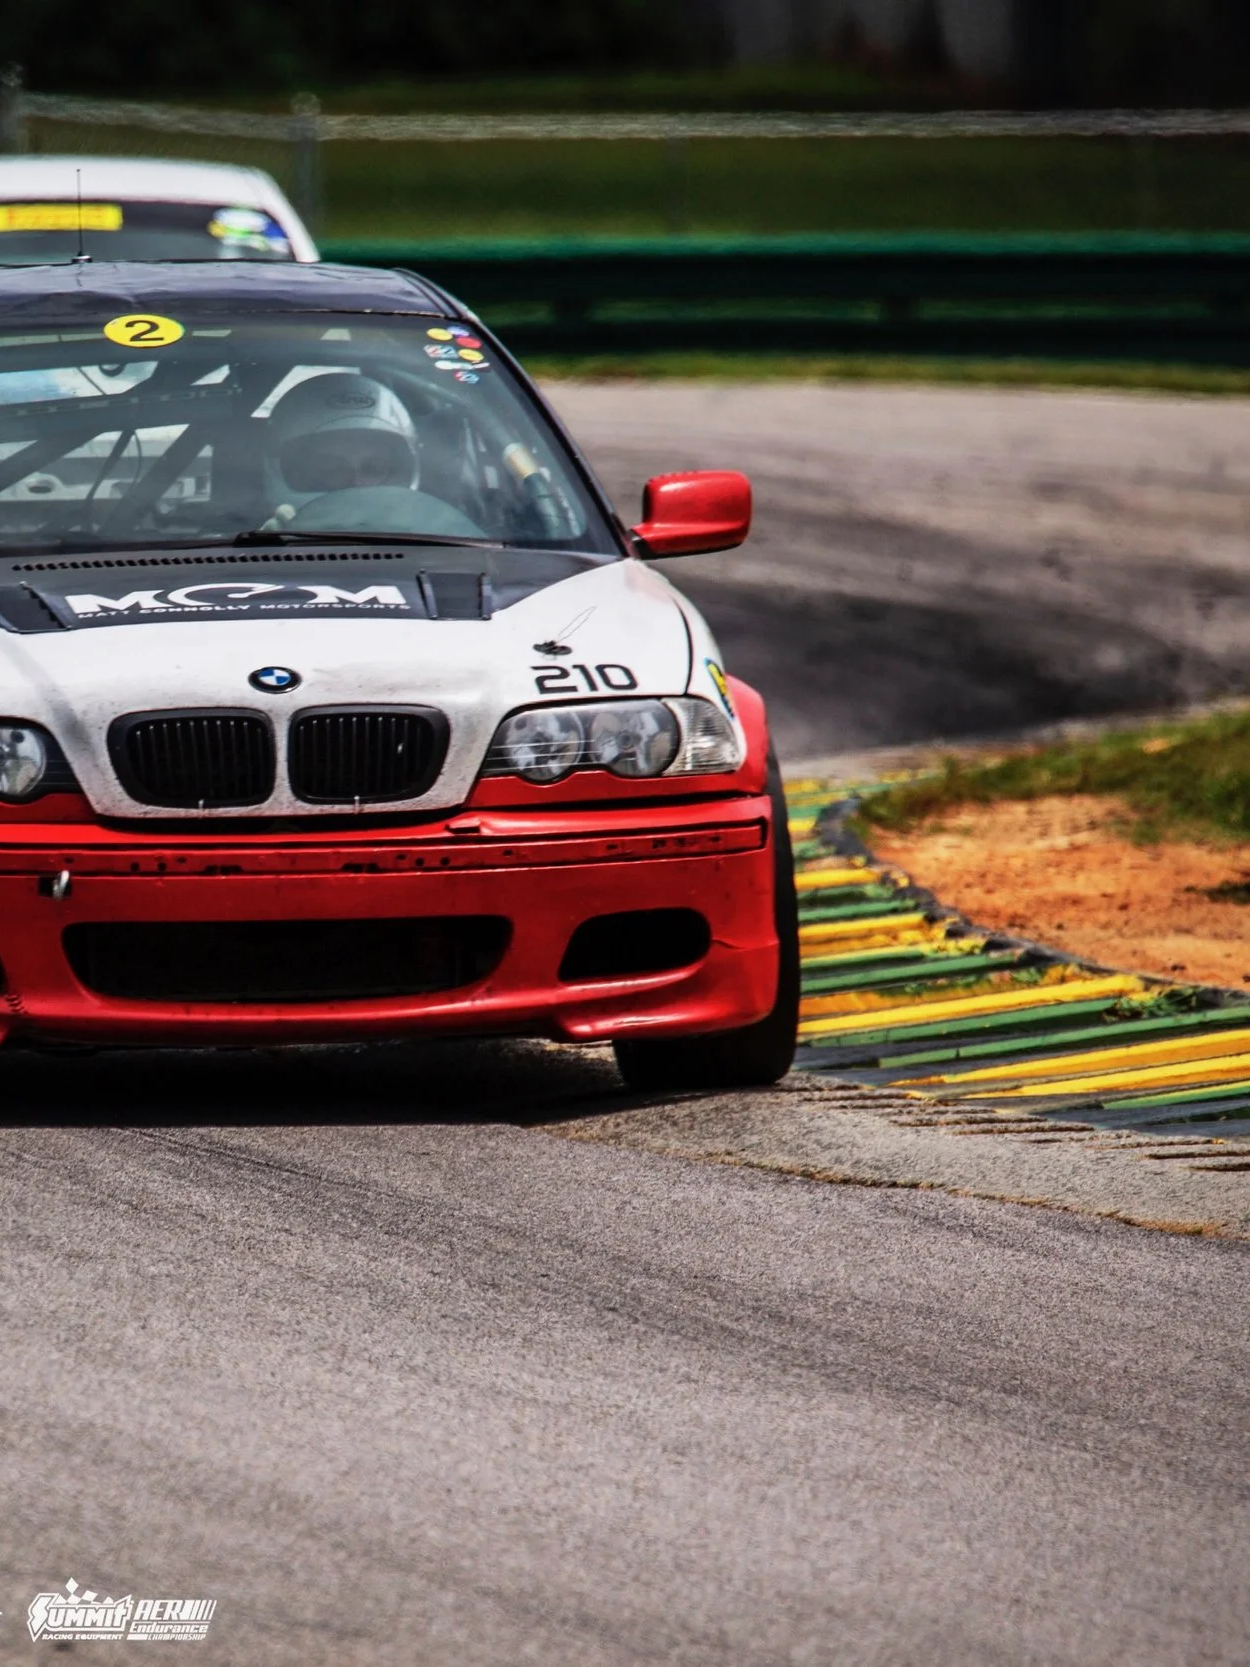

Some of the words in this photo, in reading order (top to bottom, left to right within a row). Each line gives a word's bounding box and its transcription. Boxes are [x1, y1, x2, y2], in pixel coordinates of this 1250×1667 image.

[125, 319, 165, 342] 2
[77, 610, 131, 619] MATT
[139, 603, 251, 614] CONNOLLY
[259, 602, 412, 610] MOTORSPORTS
[530, 663, 639, 695] 210
